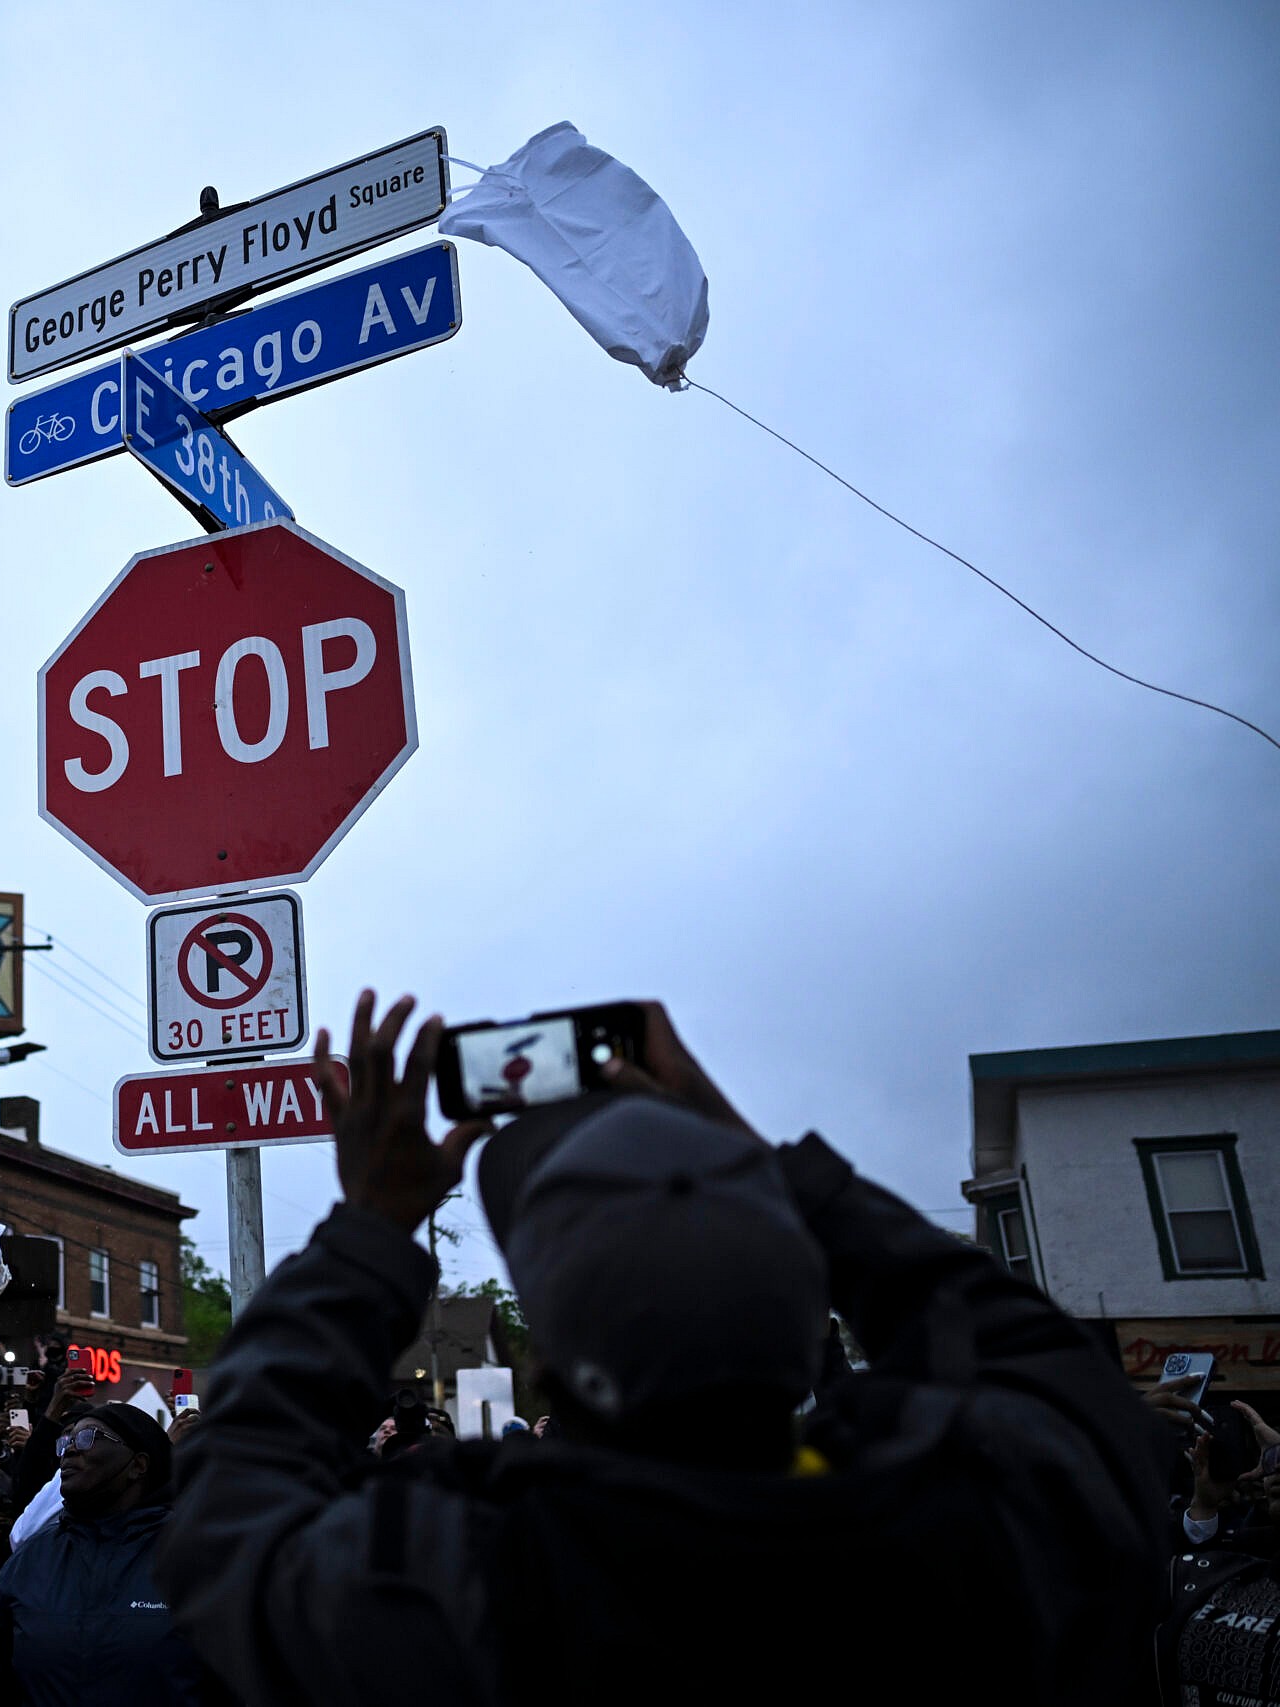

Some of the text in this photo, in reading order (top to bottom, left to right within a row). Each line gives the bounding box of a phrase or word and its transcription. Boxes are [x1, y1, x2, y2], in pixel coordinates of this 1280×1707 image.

[26, 165, 425, 353] George Perry Floyd Square
[91, 276, 438, 435] Cicago Av
[136, 376, 251, 526] E 38th
[64, 617, 377, 793] STOP
[168, 1008, 289, 1050] 30 FEET
[135, 1077, 324, 1136] ALL WAY
[1213, 1612, 1276, 1634] ARE
